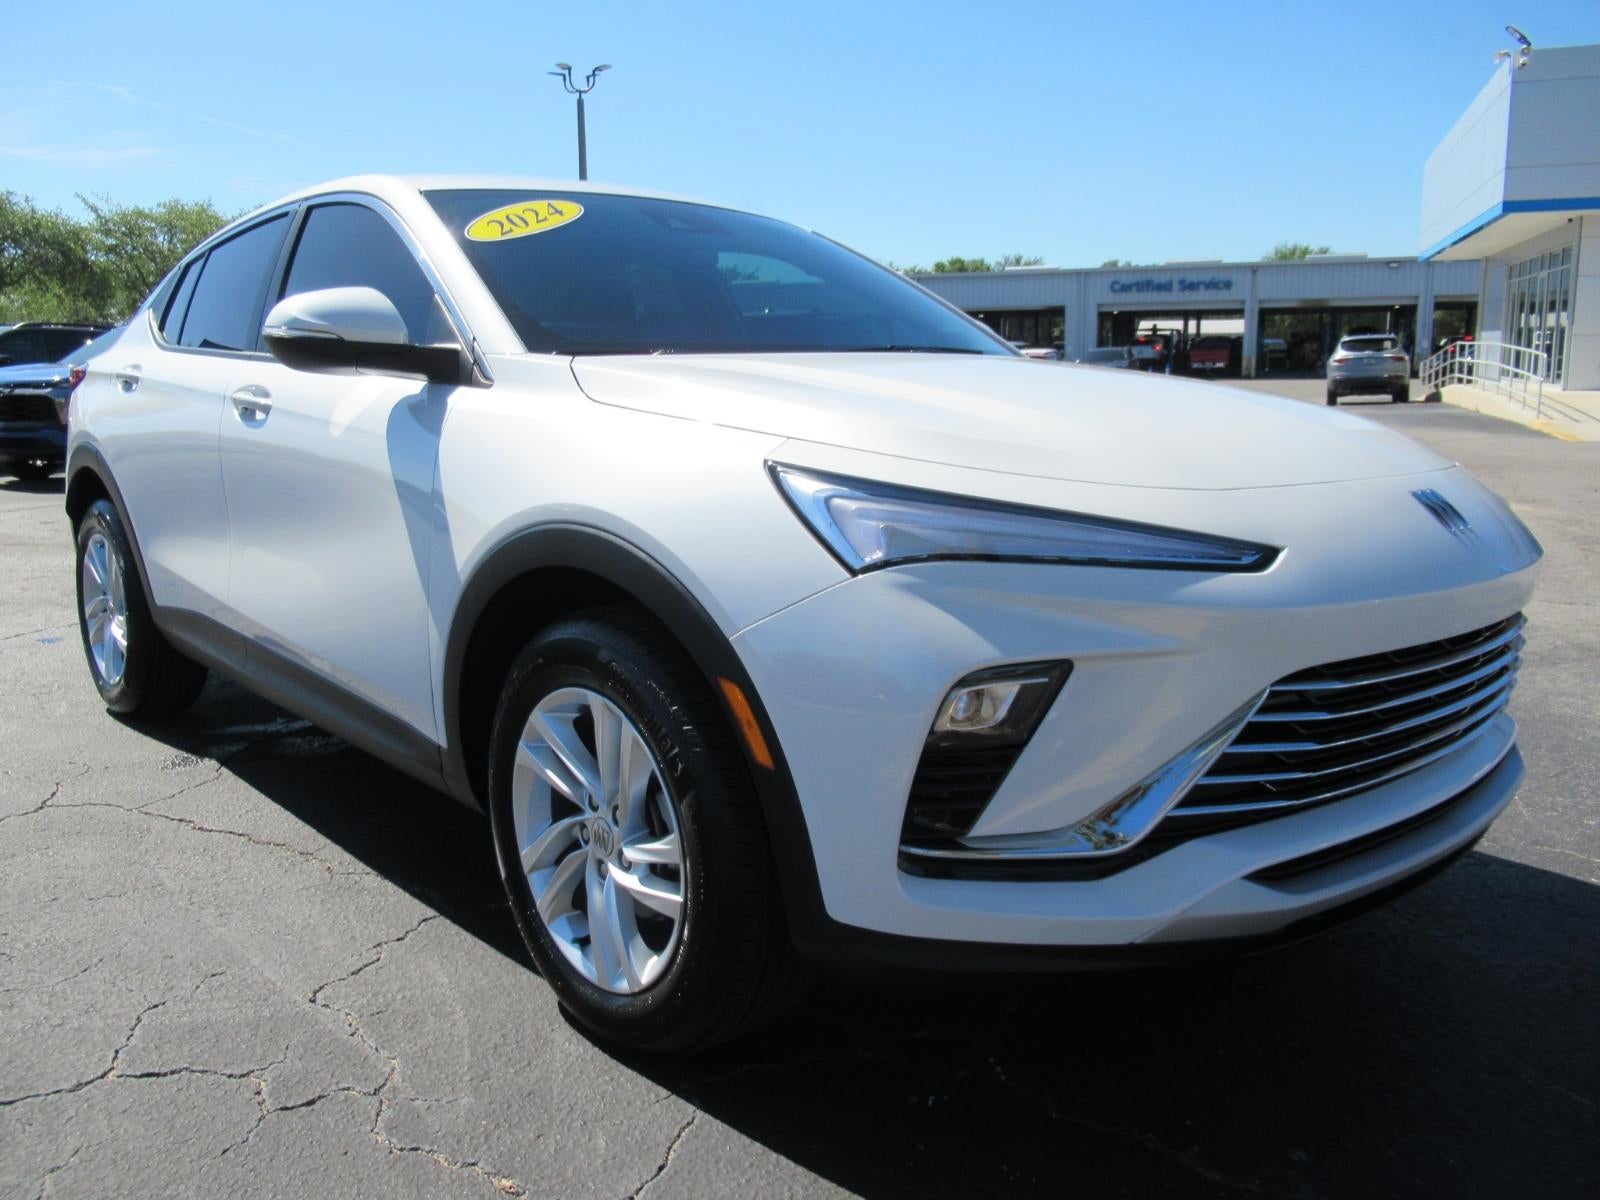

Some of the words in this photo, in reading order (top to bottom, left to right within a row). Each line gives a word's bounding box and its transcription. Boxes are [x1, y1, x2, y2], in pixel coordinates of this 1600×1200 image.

[487, 202, 564, 236] 2024
[1110, 279, 1173, 293] Certified
[1178, 277, 1233, 291] Service
